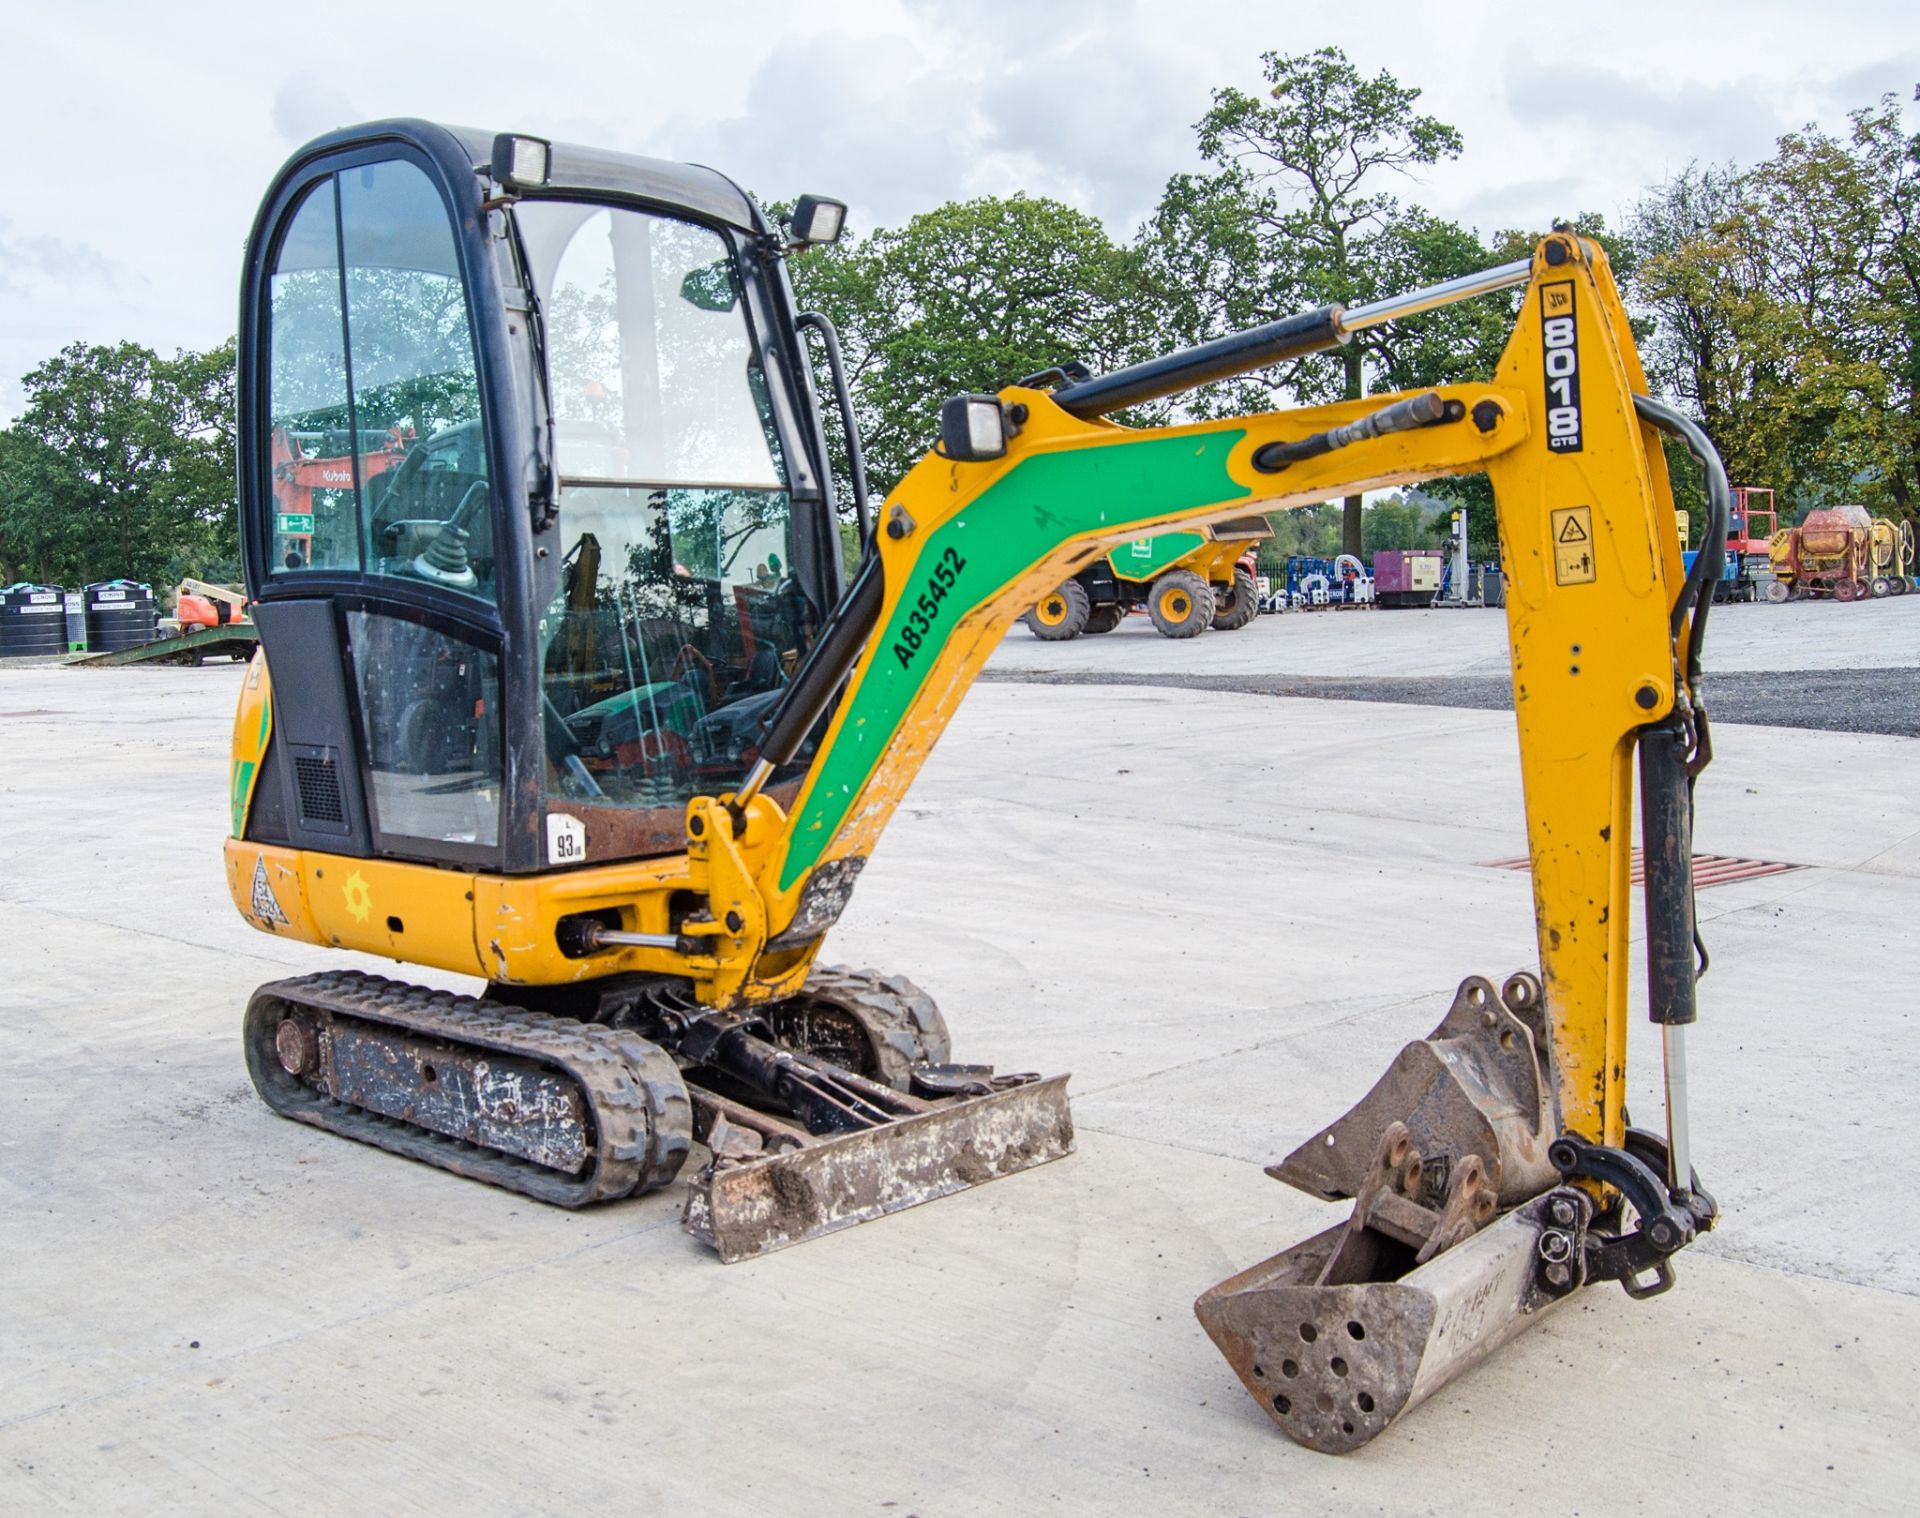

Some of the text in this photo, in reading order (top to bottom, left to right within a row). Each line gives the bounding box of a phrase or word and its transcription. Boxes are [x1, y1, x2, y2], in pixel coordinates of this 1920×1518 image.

[1544, 318, 1579, 436] 8018
[323, 470, 351, 482] Kubota
[893, 547, 966, 670] A835452
[557, 834, 573, 857] 93
